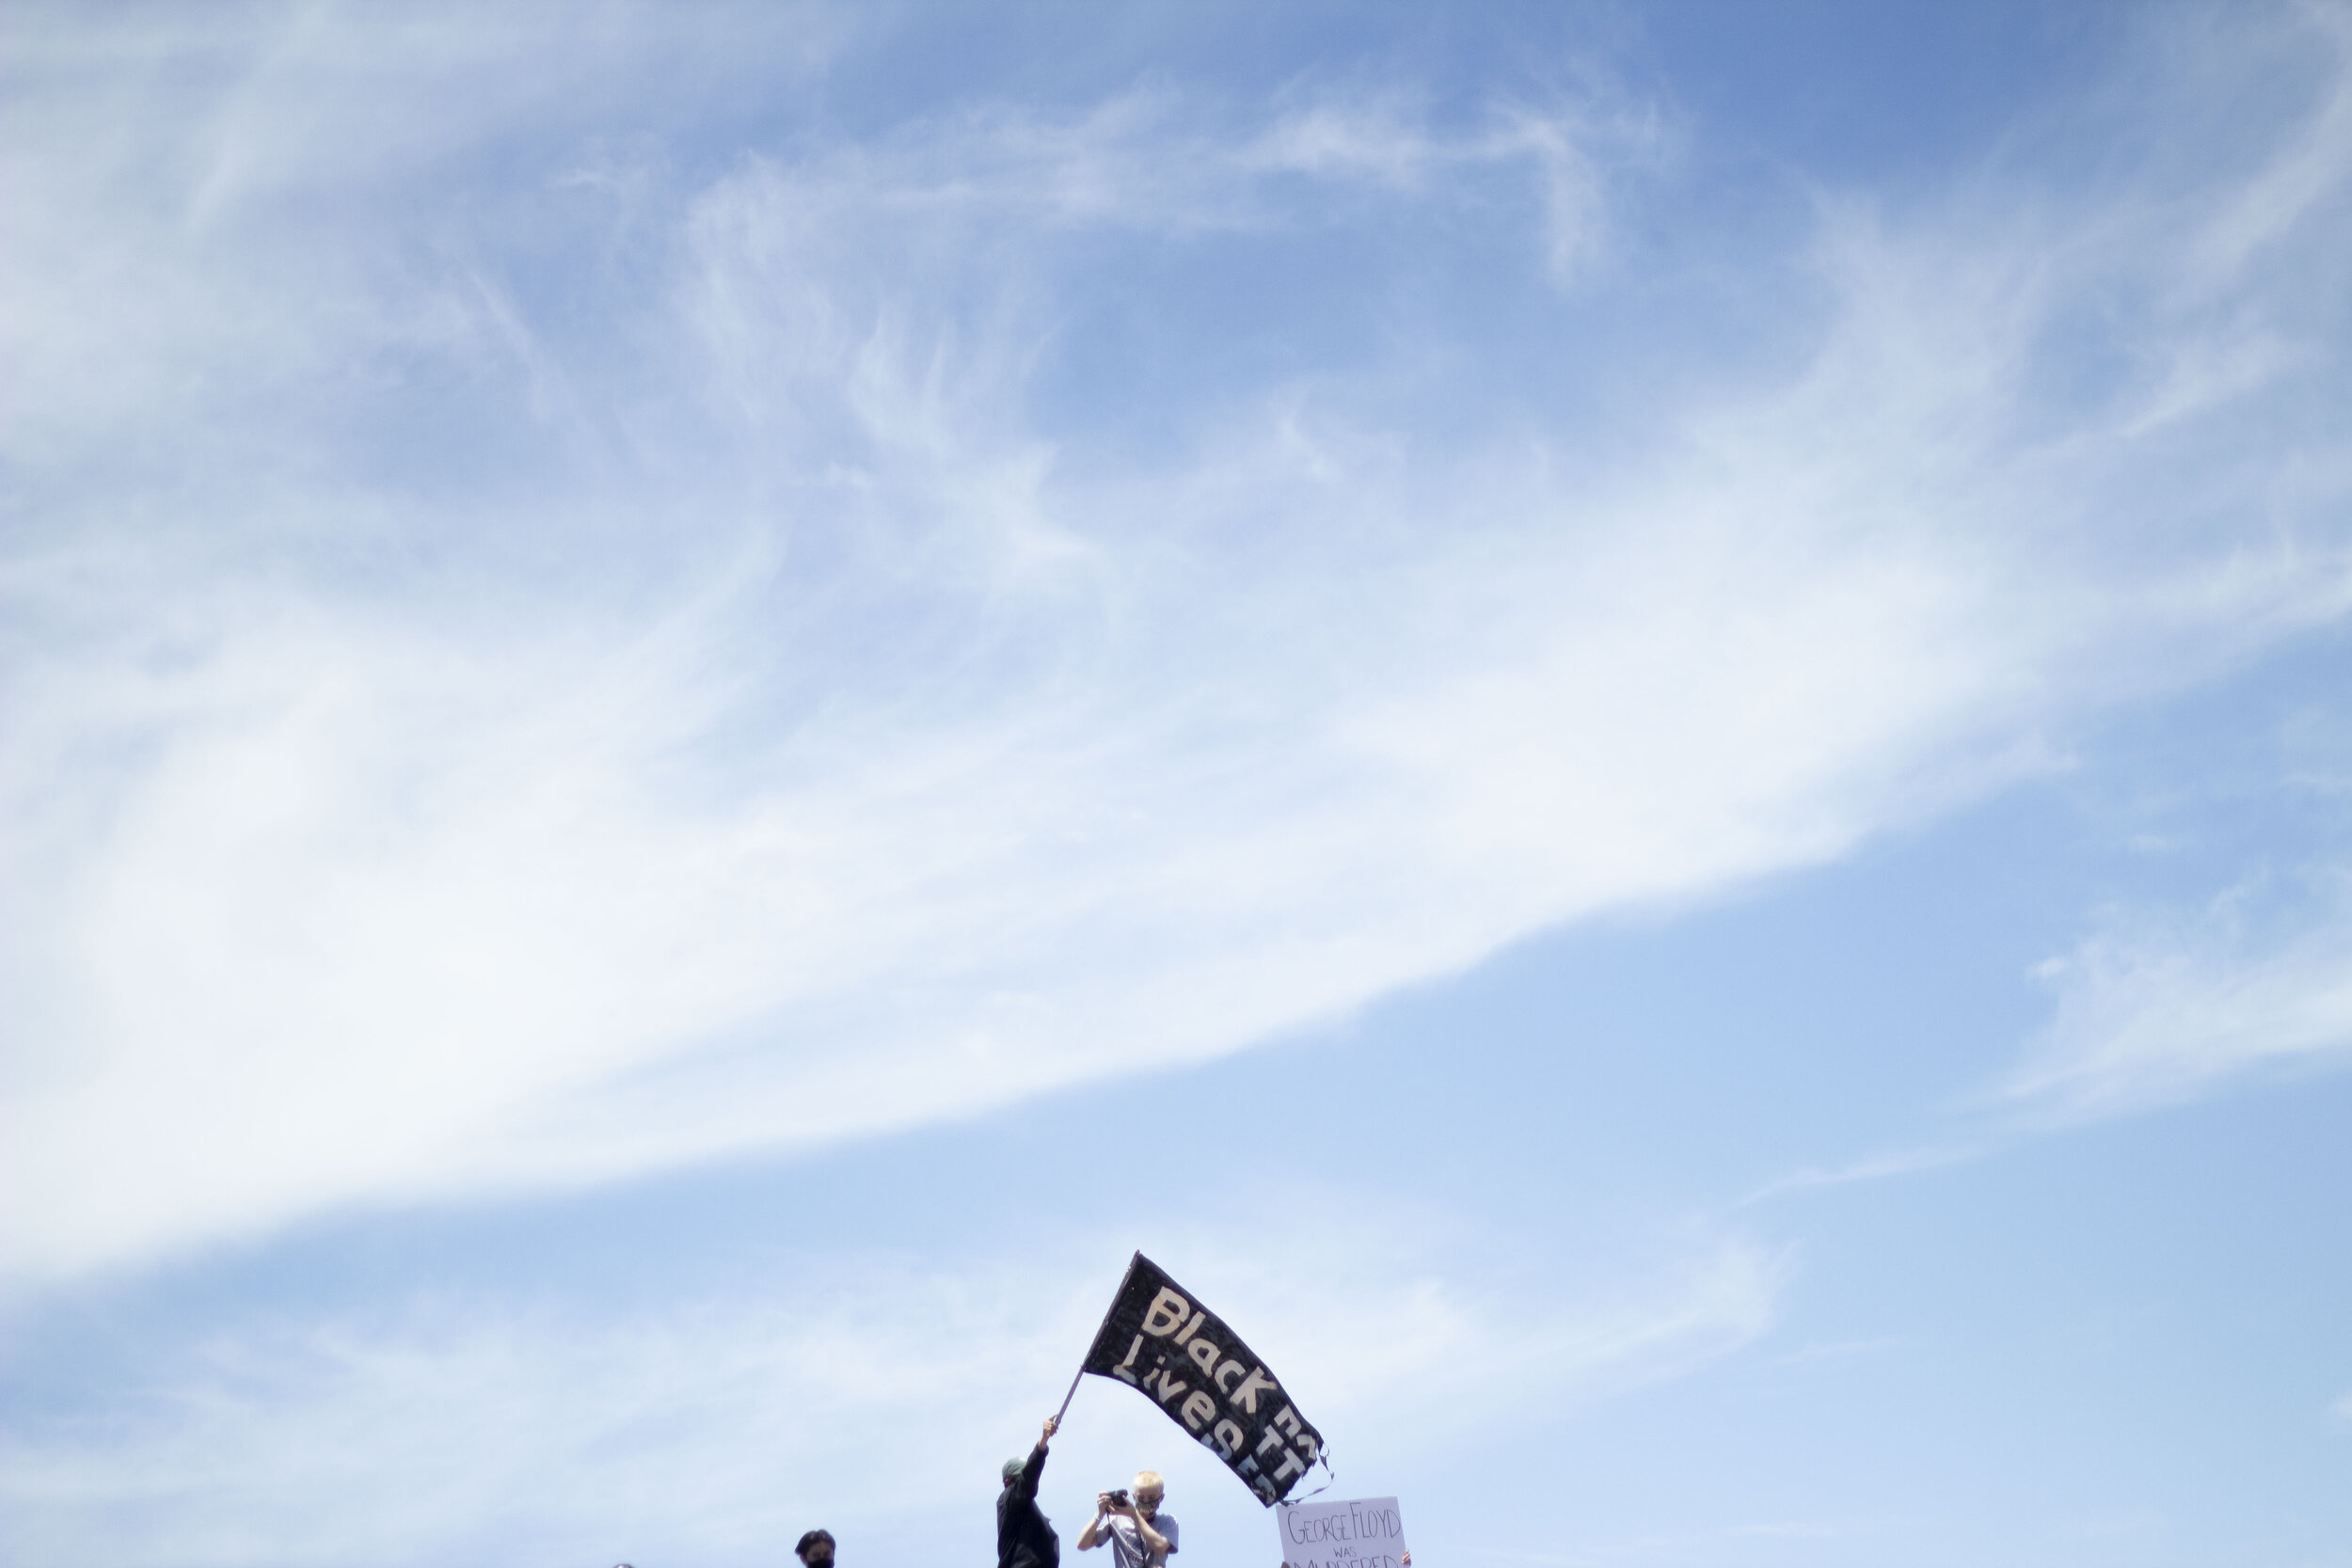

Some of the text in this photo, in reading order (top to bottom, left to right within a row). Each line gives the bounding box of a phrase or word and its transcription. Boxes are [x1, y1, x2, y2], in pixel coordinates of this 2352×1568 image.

[1287, 1502, 1401, 1545] GEORGE FLOYD
[1333, 1546, 1357, 1558] WAS
